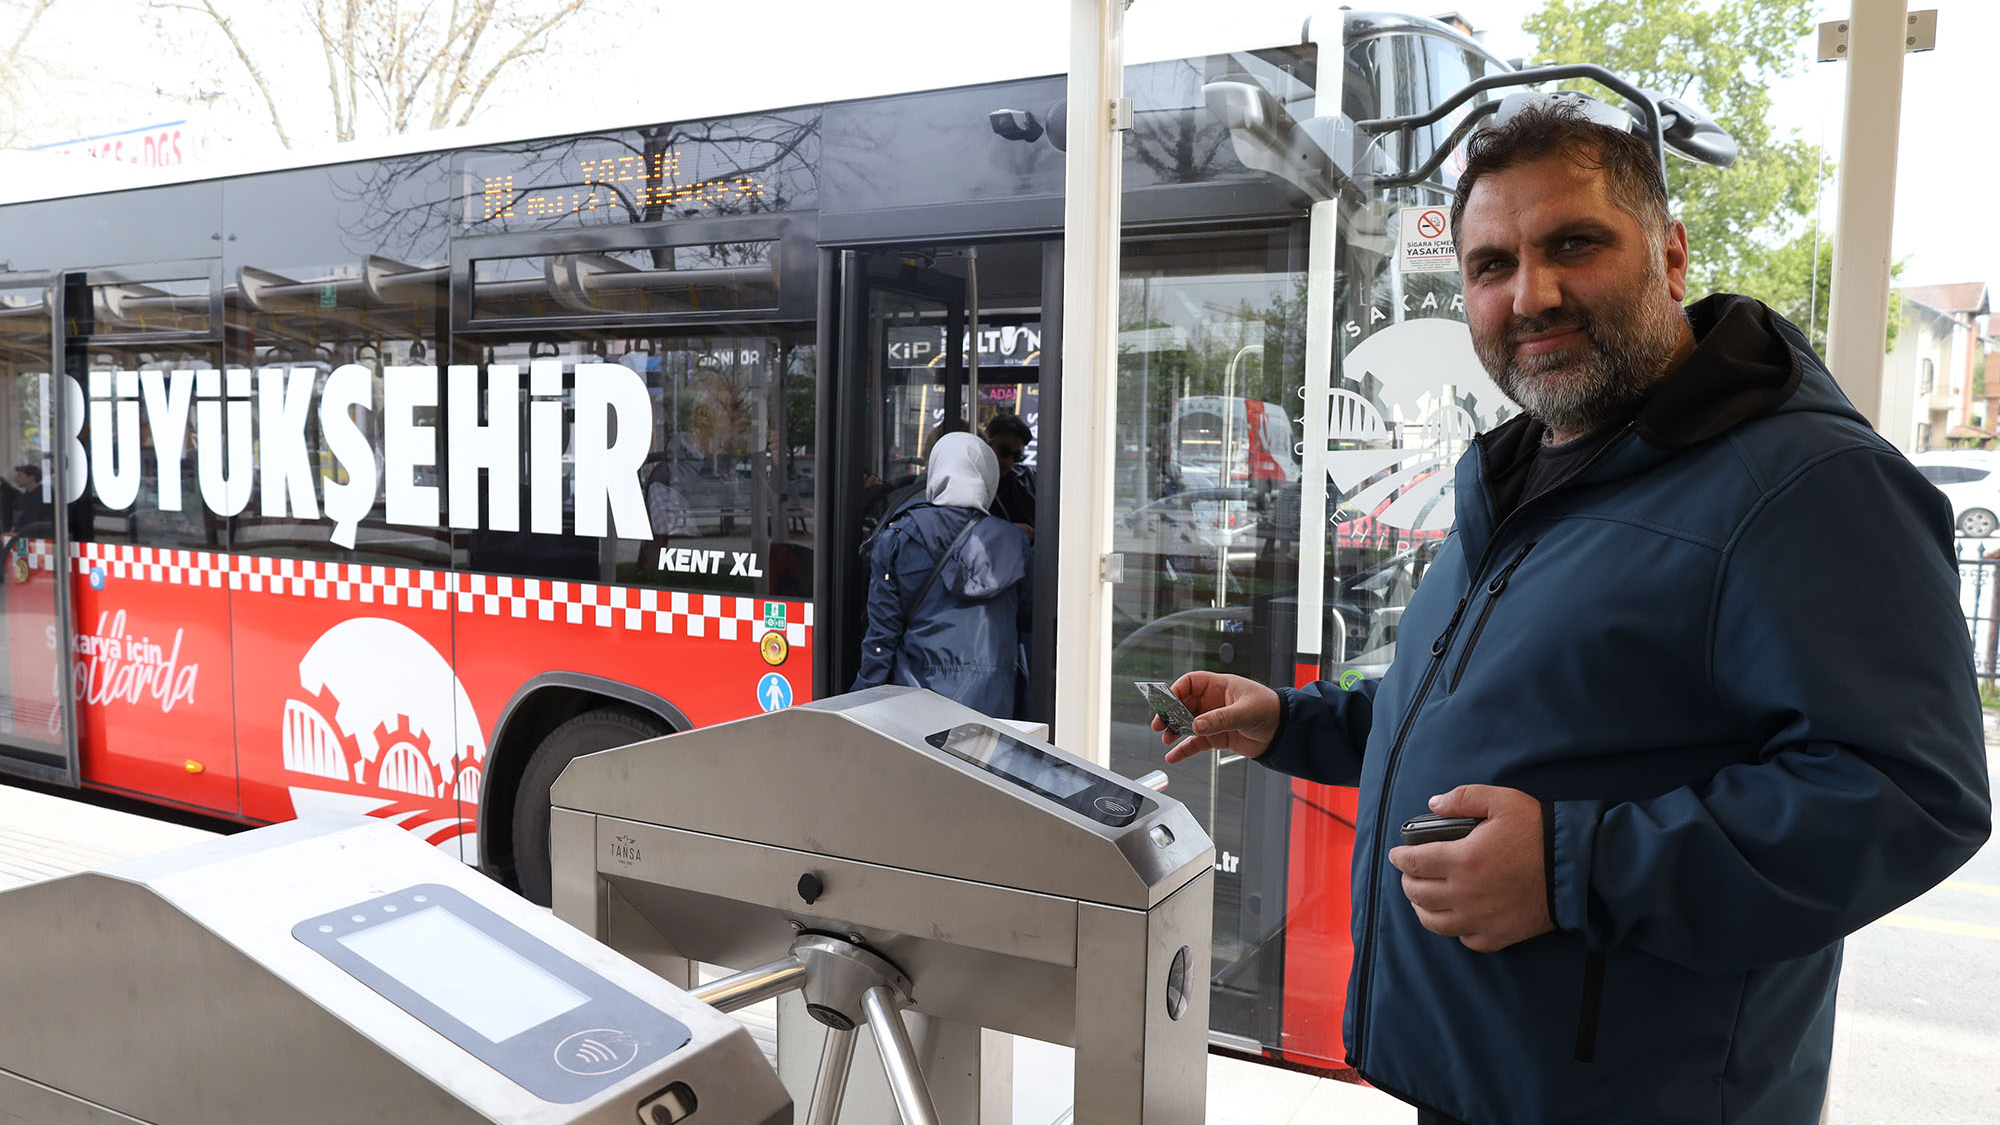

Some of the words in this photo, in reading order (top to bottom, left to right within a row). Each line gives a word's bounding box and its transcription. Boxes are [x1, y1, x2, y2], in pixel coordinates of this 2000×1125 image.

[1406, 246, 1456, 256] YASAKTIR
[40, 360, 654, 549] BÜYÜKŞEHİR
[657, 547, 725, 575] KENT
[729, 551, 763, 578] XL
[45, 624, 123, 663] Skarya
[126, 634, 163, 667] için
[610, 843, 642, 861] TANSA
